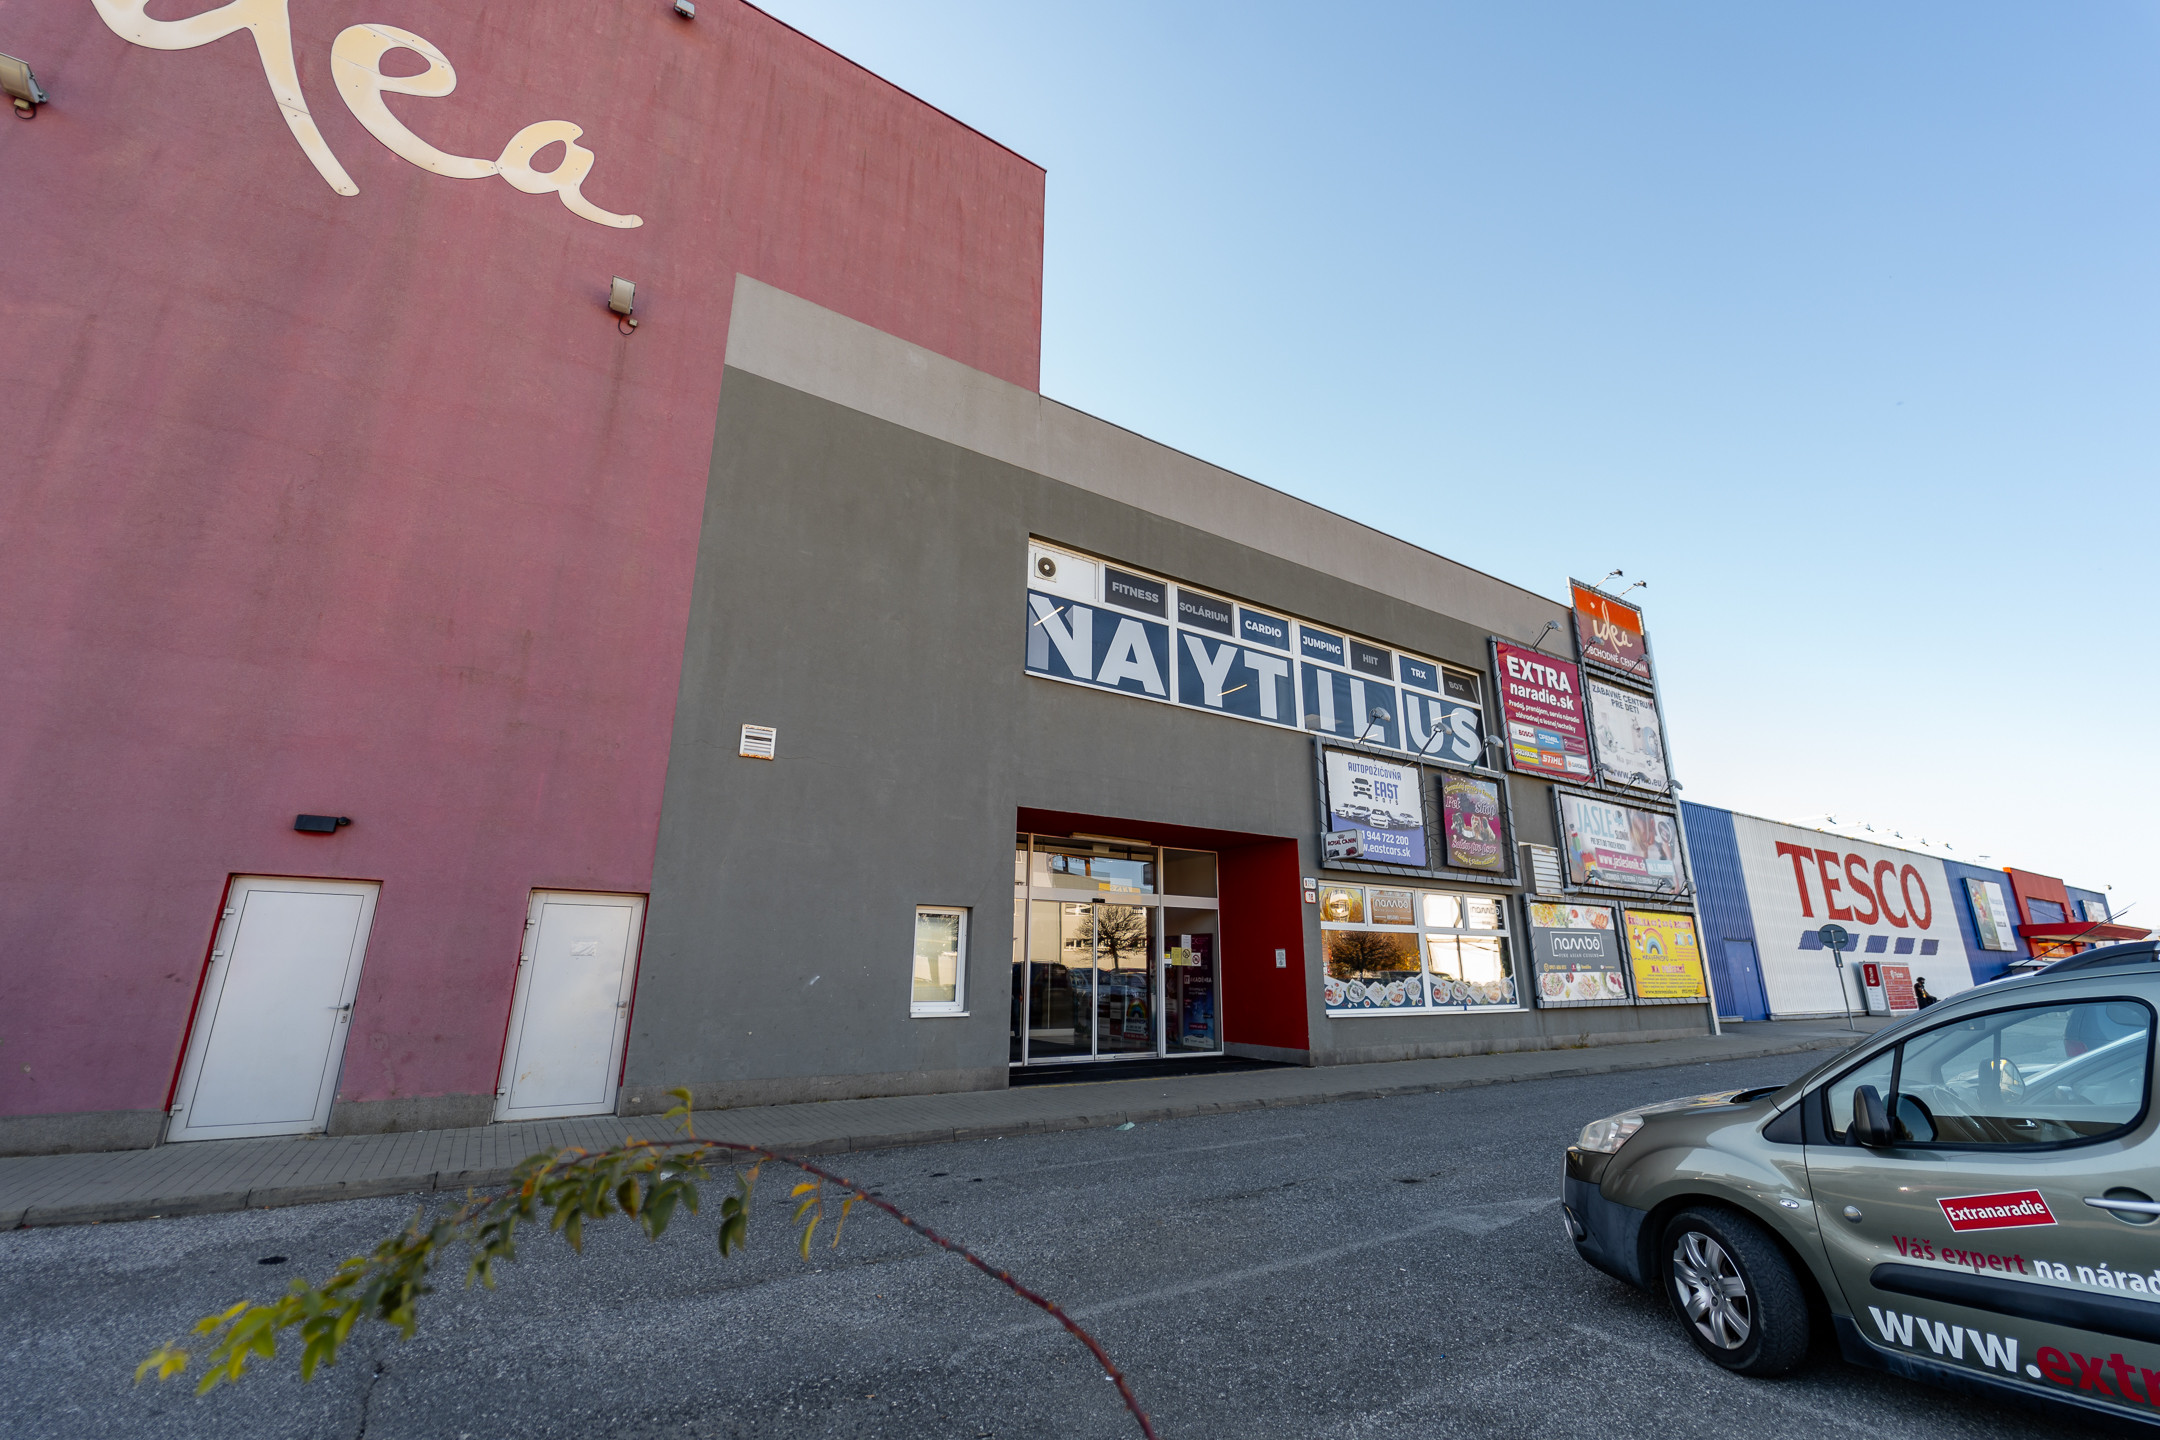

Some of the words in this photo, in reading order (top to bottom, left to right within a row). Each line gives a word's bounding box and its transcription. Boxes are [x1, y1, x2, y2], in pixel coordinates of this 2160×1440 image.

[88, 0, 644, 229] ea
[1112, 581, 1160, 604] FITNESS
[1179, 602, 1229, 624] SOLÁRIUM
[1245, 619, 1282, 638] CARDIO
[1589, 600, 1634, 654] idea
[1302, 636, 1341, 655] JUMPING
[1362, 653, 1379, 666] HIIT
[1584, 644, 1620, 664] OBCHODNÉ
[1620, 656, 1647, 673] CENTRUM
[1027, 592, 1479, 763] NAYTILUS
[1410, 667, 1427, 680] TRX
[1506, 654, 1573, 695] EXTRA
[1448, 680, 1465, 692] BOX
[1509, 682, 1575, 711] naradie.sk
[1611, 699, 1624, 710] PRE
[1518, 729, 1535, 739] BOSCH
[1542, 753, 1564, 766] STIHL
[1347, 761, 1402, 781] AUTOPOŽIČOVŇA
[1374, 779, 1399, 800] EAST
[1446, 796, 1461, 810] Pet
[1576, 802, 1615, 839] JASLE
[1366, 830, 1381, 843] 944
[1382, 832, 1395, 845] 722
[1396, 835, 1409, 847] 200
[1775, 841, 1932, 930] TESCO
[1946, 1199, 2047, 1222] Extranaradie
[1892, 1235, 1936, 1261] Váš
[1941, 1245, 2029, 1276] expert
[2033, 1258, 2072, 1283] na
[2076, 1259, 2160, 1297] nárad
[1868, 1305, 2160, 1408] www.extr
